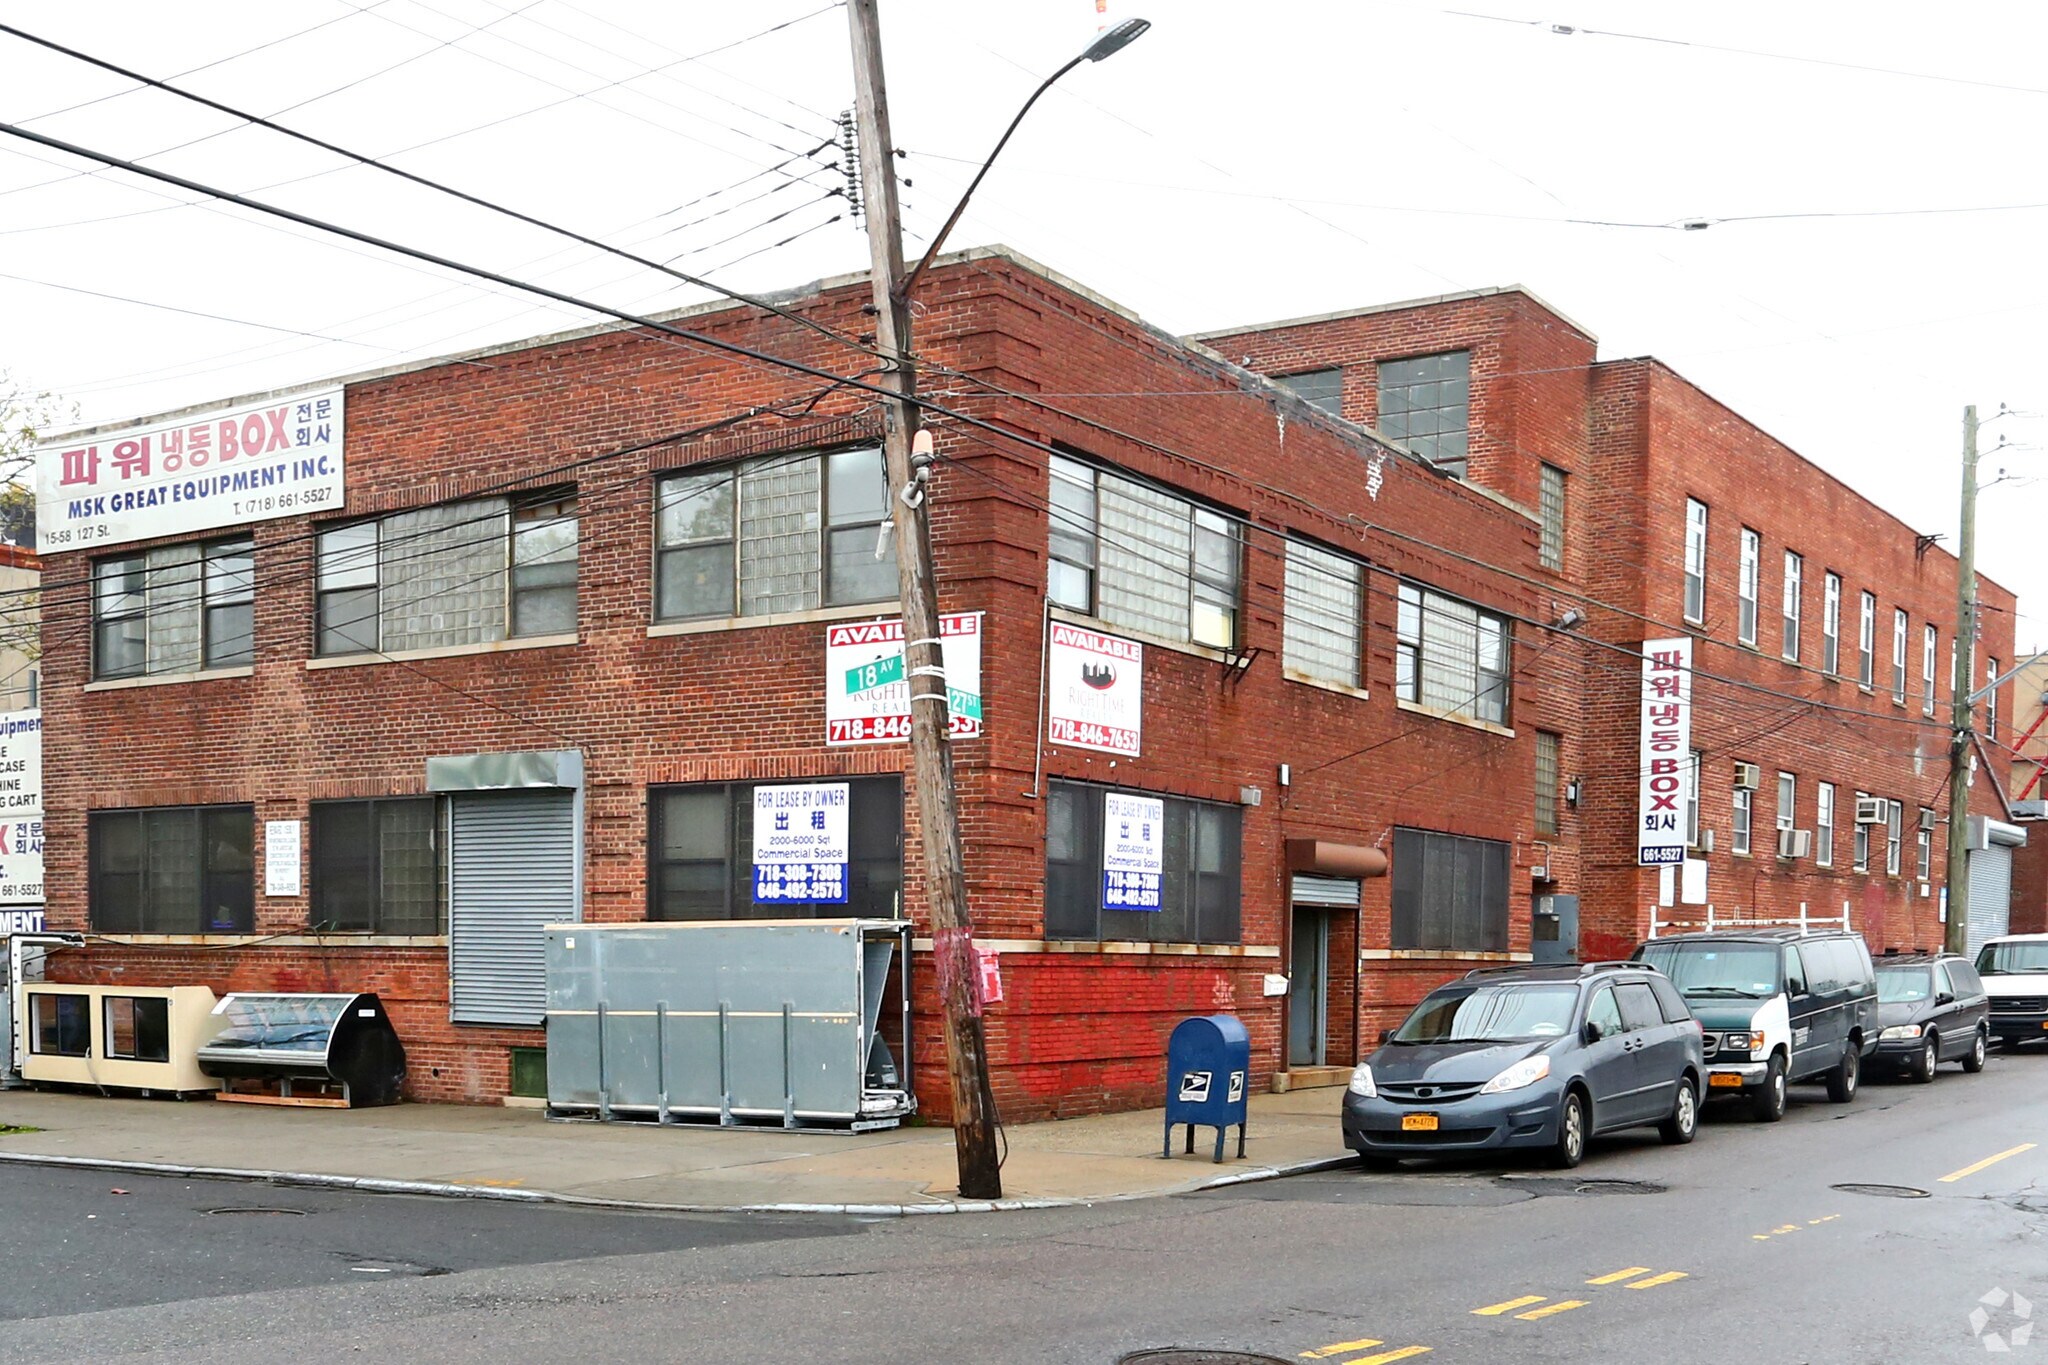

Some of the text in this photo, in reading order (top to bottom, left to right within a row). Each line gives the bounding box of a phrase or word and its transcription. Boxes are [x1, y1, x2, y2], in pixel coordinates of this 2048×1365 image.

[296, 399, 332, 424] 전문
[295, 423, 331, 447] 회사
[60, 407, 291, 487] 파워 냉동 BOX
[68, 455, 336, 519] MSK GREAT EQUIPMENT INC.
[245, 498, 275, 514] (718)
[278, 487, 332, 509] 661-5527
[45, 525, 110, 545] 15-58 127 St.
[832, 617, 976, 646] AVAILBLE
[1054, 627, 1140, 661] AVAILABLE
[858, 660, 894, 689] 18 AV
[872, 701, 908, 714] REAL
[946, 687, 977, 712] 127 ST
[1053, 718, 1138, 751] 718-846-7653
[1649, 650, 1683, 811] 파워 냉동 BOX
[9, 794, 37, 807] CART
[757, 789, 845, 808] FOR LEASE BY OWNER
[15, 822, 43, 838] 전문
[1645, 814, 1676, 831] 회사
[15, 839, 43, 854] 회사
[770, 836, 814, 845] 2000-6000
[758, 848, 843, 860] Commercial Space
[1643, 847, 1682, 862] 661-5527
[2, 884, 42, 896] 661-5527
[757, 882, 843, 899] 646-492-2578
[0, 911, 44, 932] MENT
